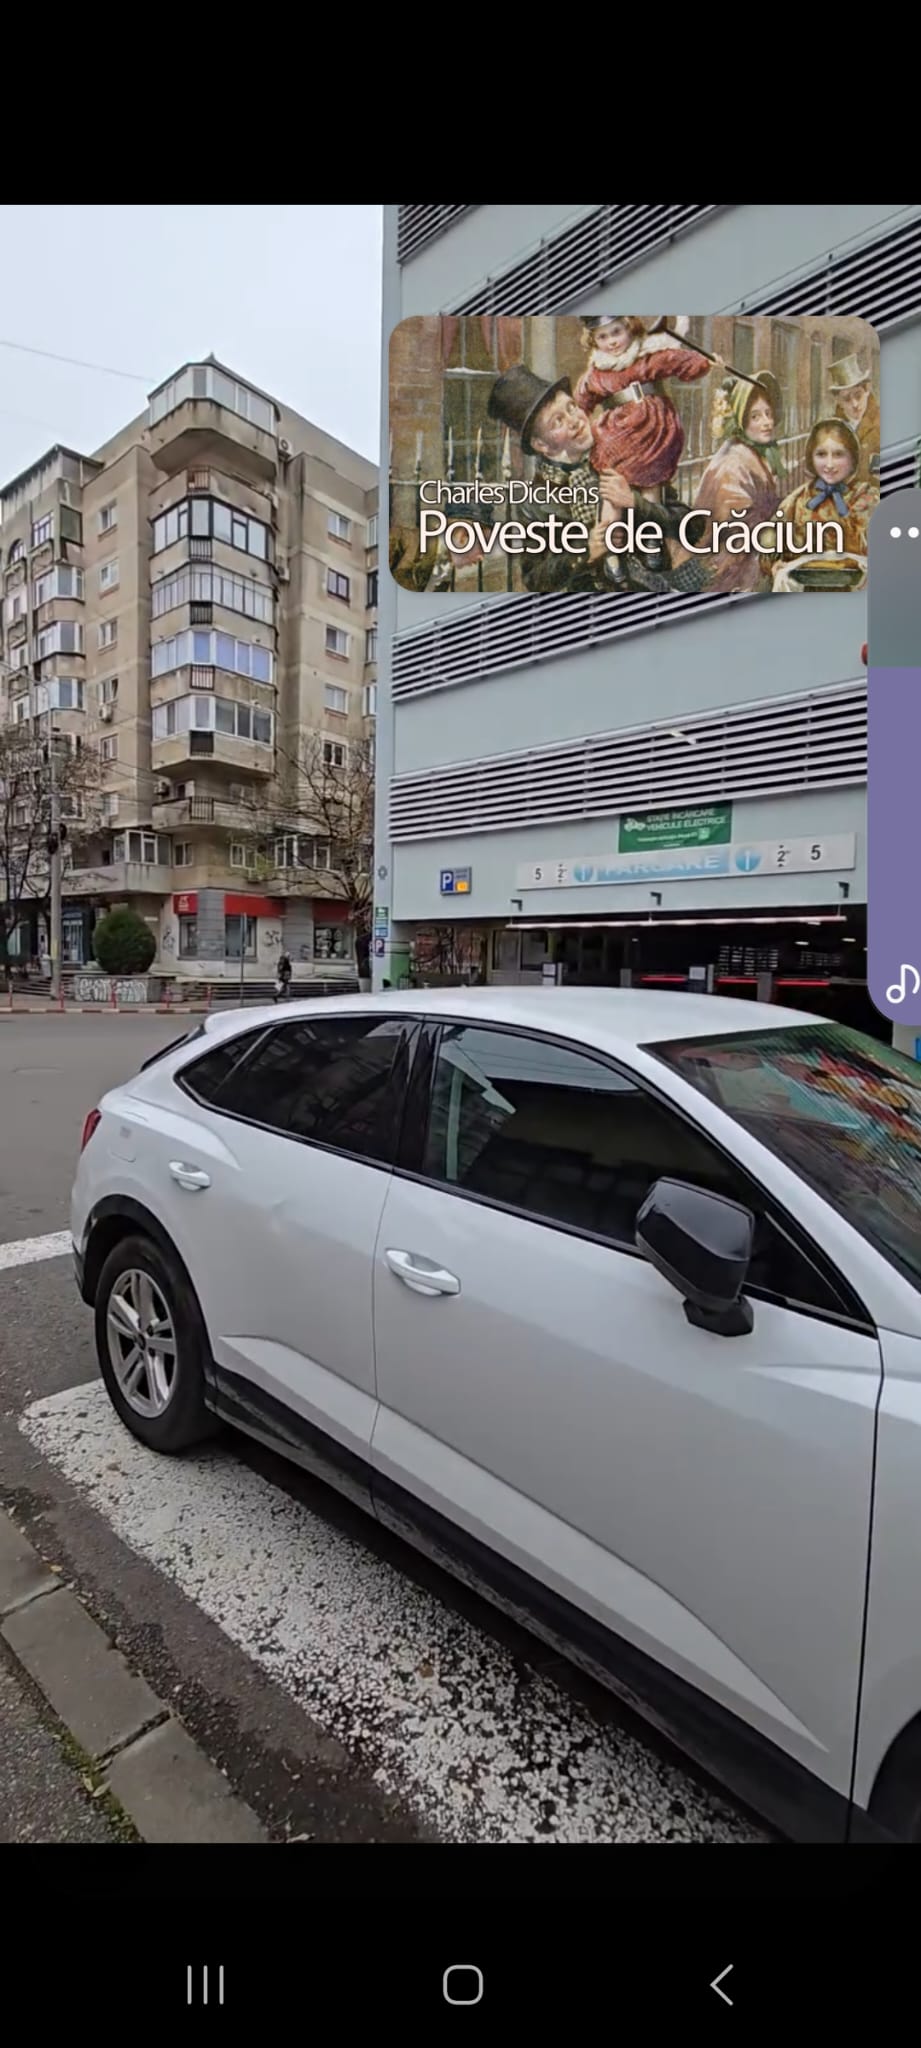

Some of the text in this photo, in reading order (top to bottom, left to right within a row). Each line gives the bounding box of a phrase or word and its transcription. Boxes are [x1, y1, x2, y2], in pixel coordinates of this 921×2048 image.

[646, 816, 726, 831] VEHICULE ELECTRICE
[534, 867, 542, 880] 5
[811, 844, 821, 861] 5
[442, 873, 452, 890] P
